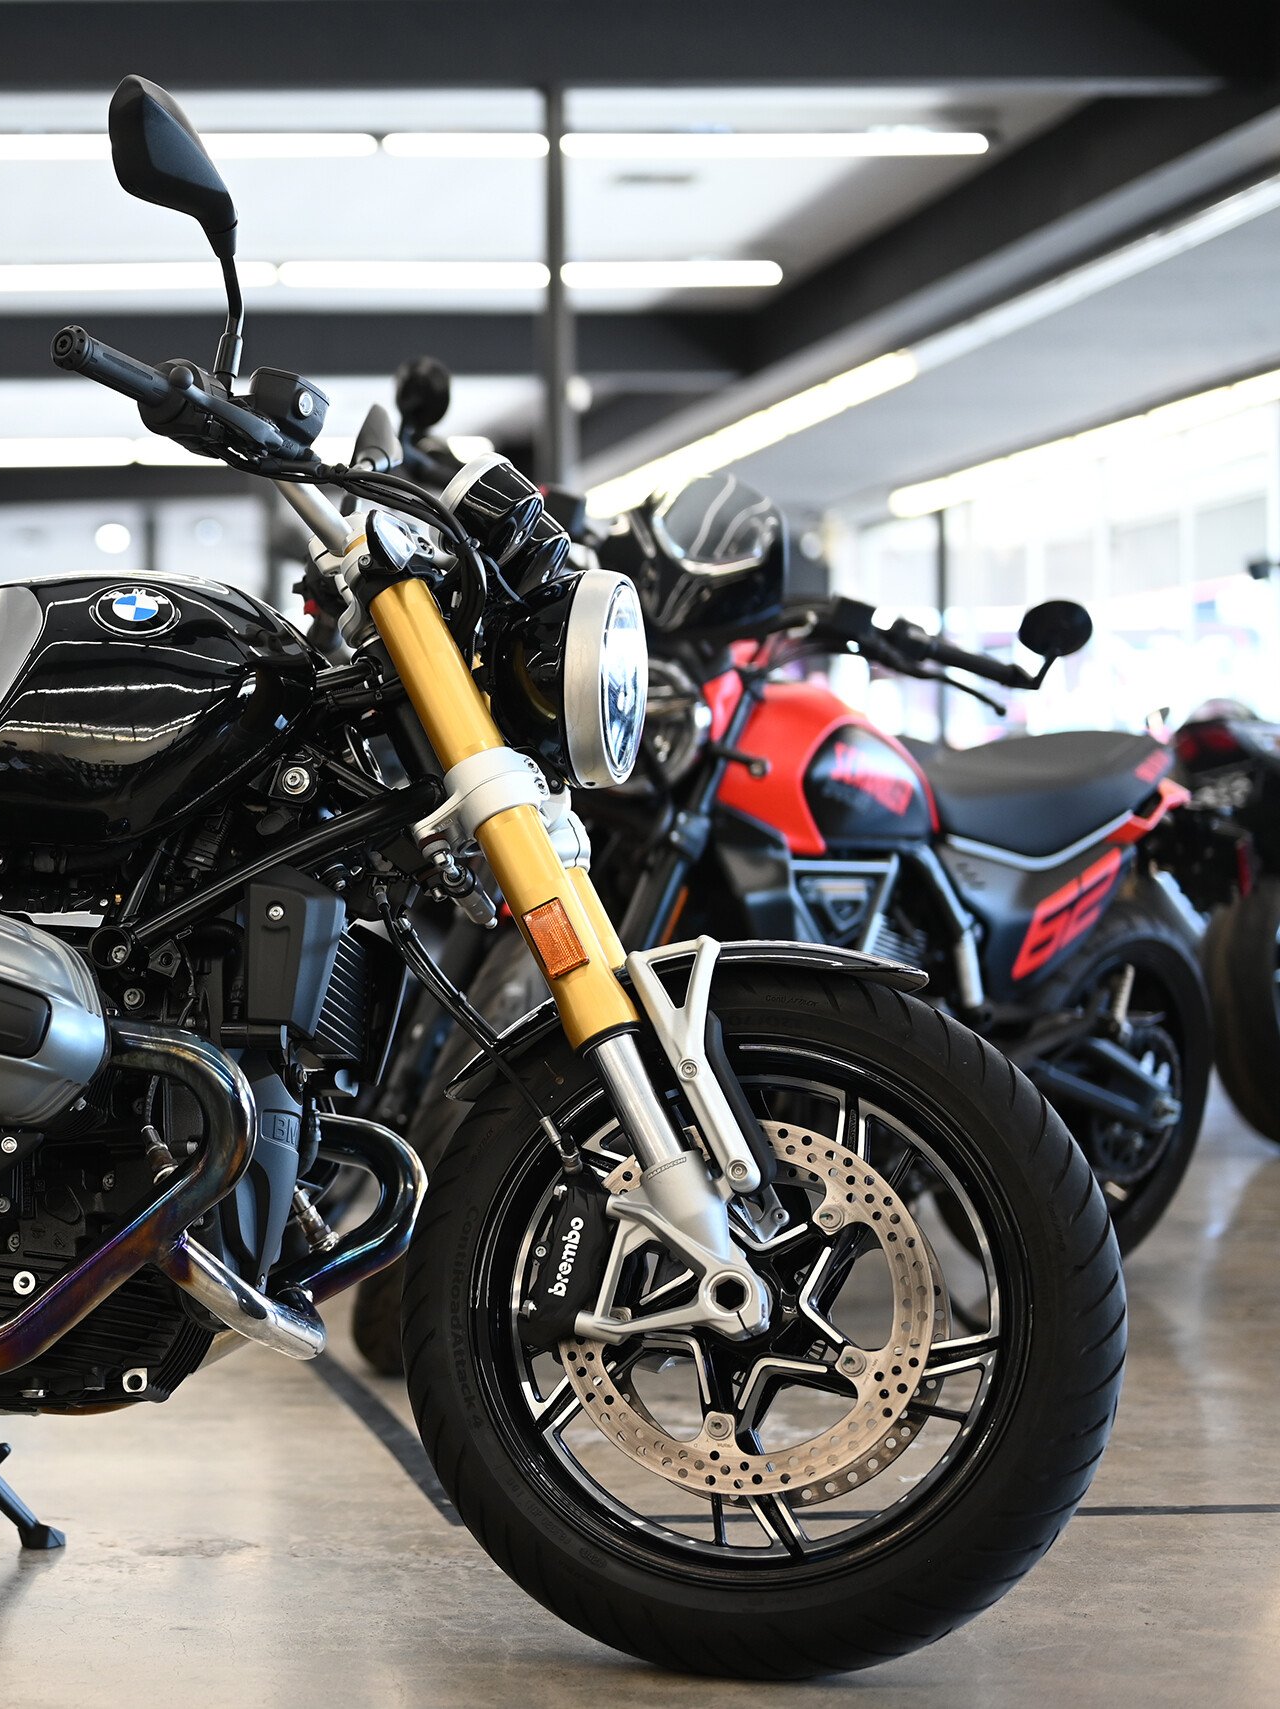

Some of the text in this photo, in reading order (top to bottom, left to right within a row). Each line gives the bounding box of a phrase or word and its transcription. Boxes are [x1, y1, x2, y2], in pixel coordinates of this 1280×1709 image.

[101, 589, 170, 605] BMW
[272, 1114, 300, 1146] BM
[548, 1216, 584, 1297] brembo
[448, 1204, 485, 1431] ContiRoadAttack 4
